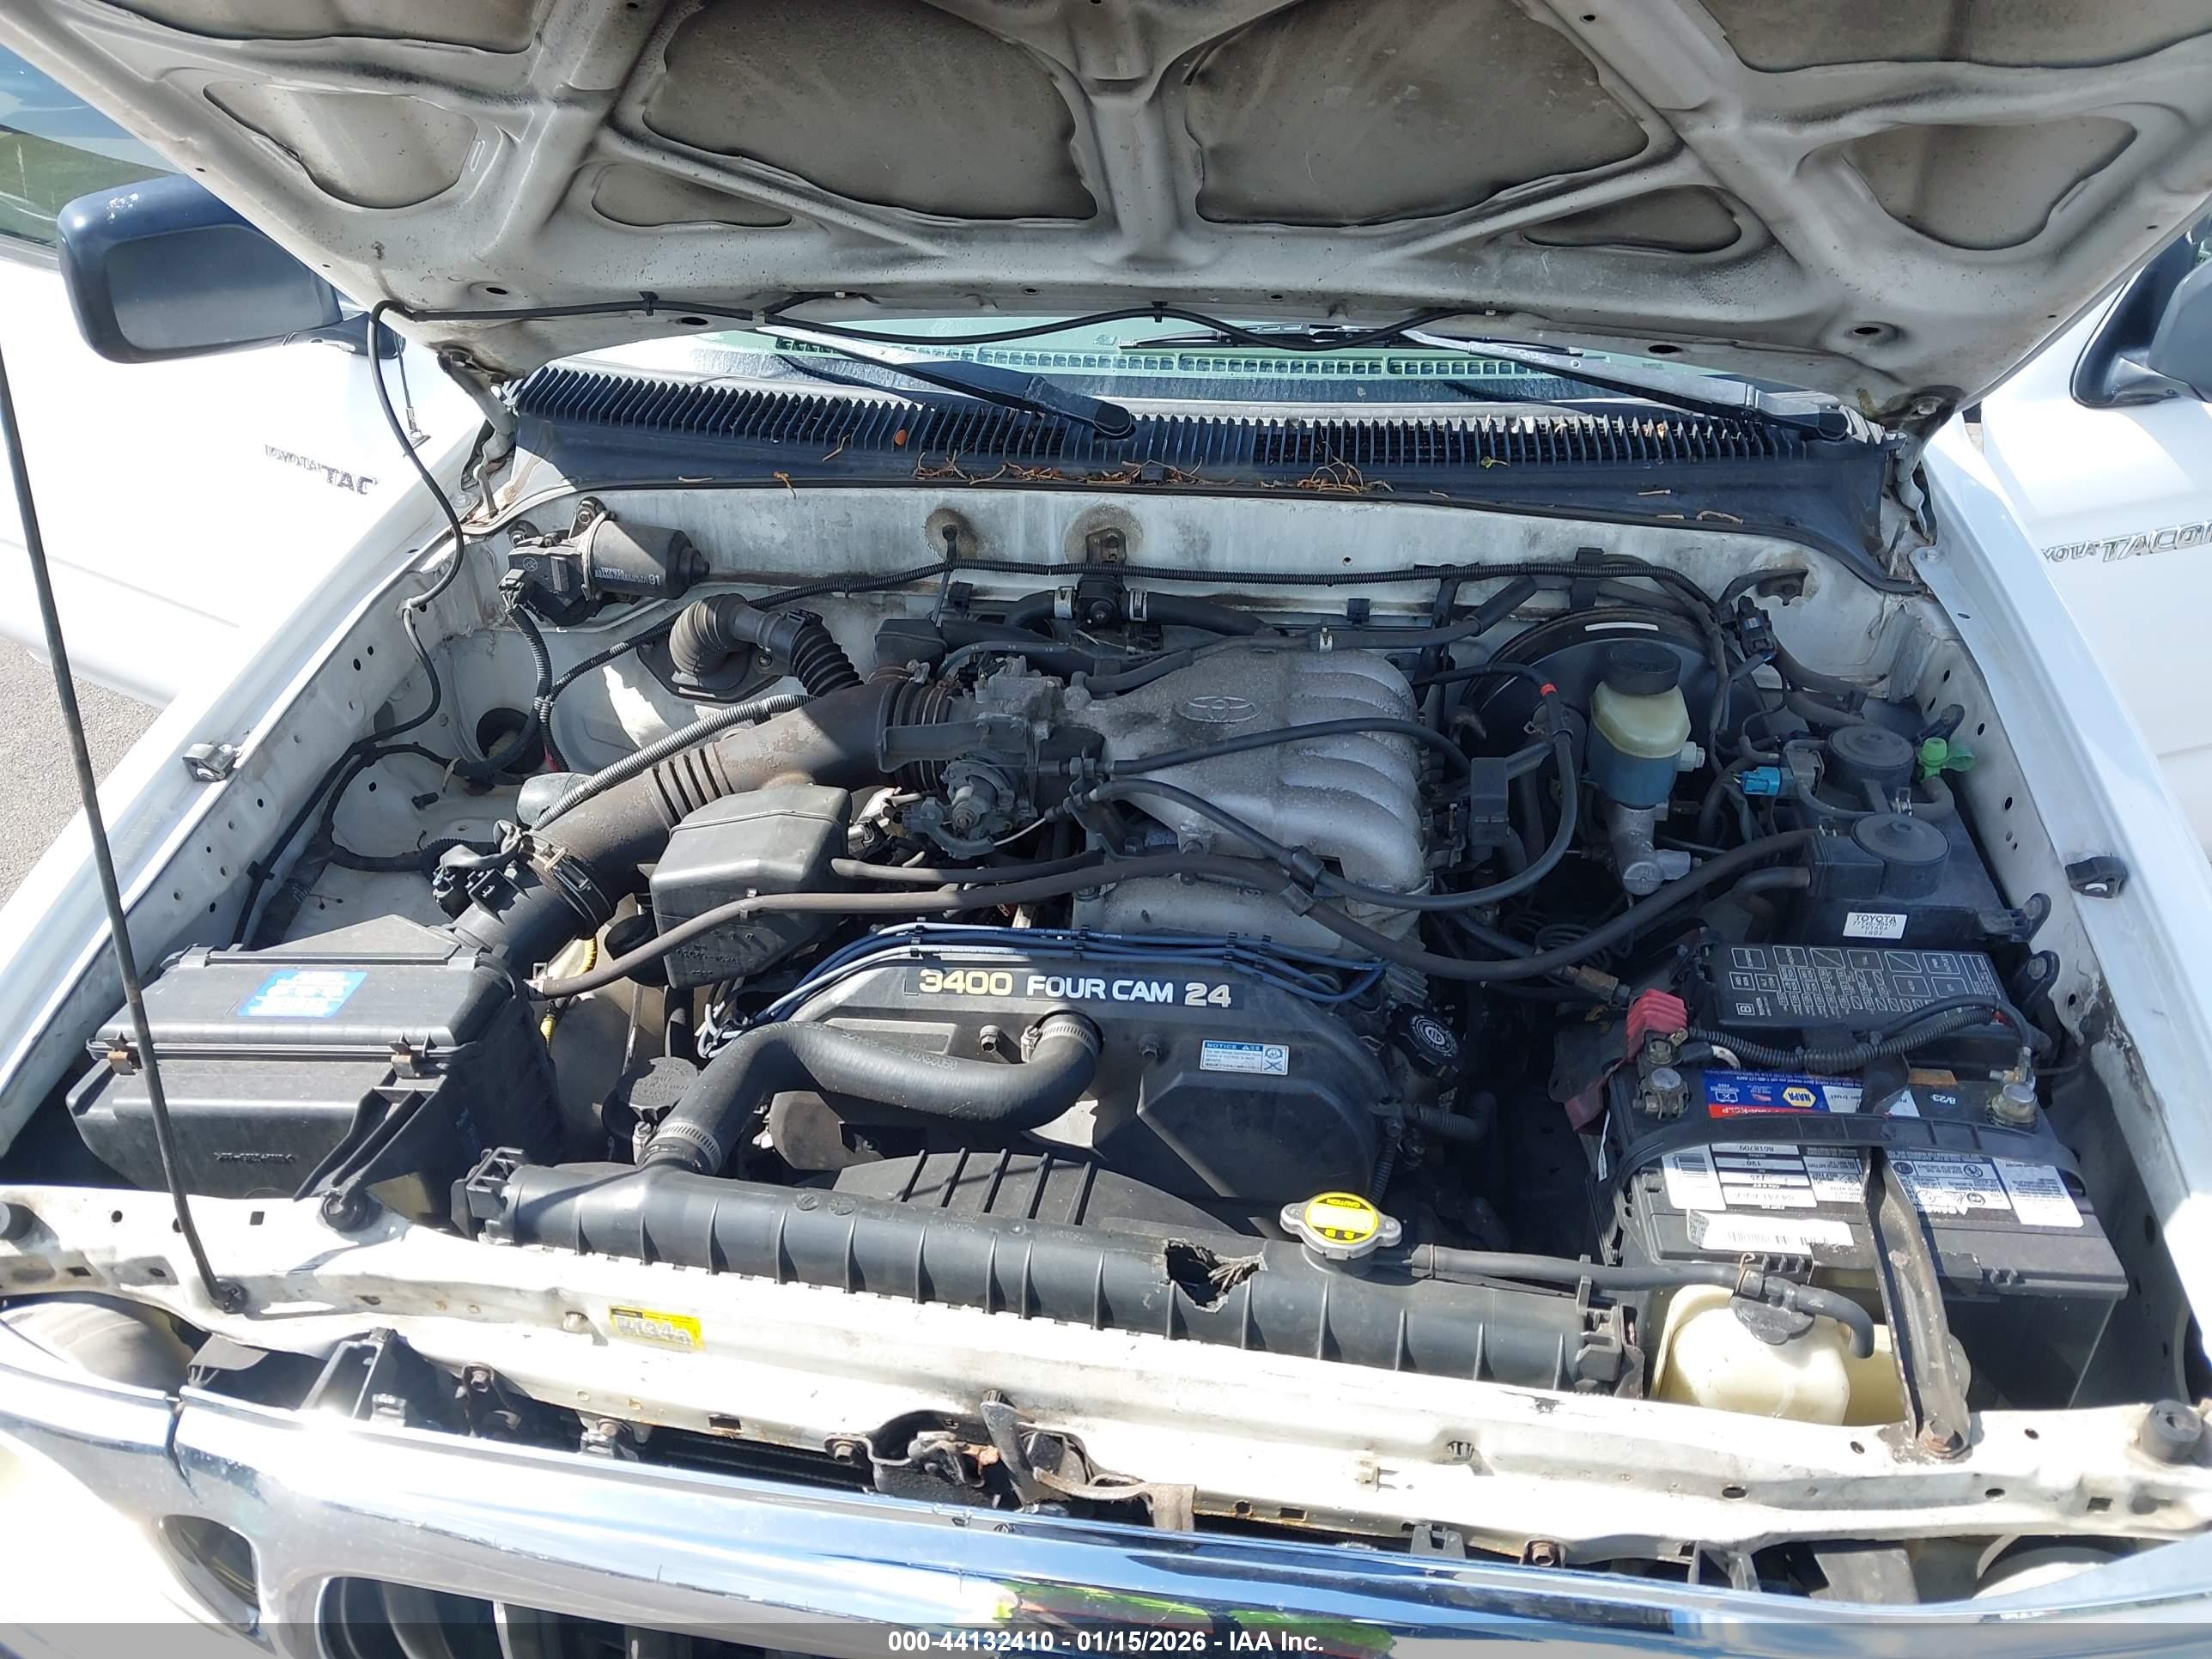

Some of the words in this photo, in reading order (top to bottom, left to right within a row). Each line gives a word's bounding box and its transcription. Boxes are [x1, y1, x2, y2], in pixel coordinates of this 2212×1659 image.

[321, 465, 379, 495] TAC
[648, 574, 660, 585] 91
[1855, 915, 1897, 923] TOYOTA
[919, 969, 1014, 997] 3400
[1026, 974, 1106, 1000] FOUR
[1112, 978, 1174, 1004] CAM
[1184, 982, 1232, 1009] 24
[1740, 1005, 1752, 1013] B
[1787, 1091, 1812, 1102] NAPA
[1930, 1093, 1956, 1105] 8/23
[1326, 1198, 1361, 1208] CAUTION
